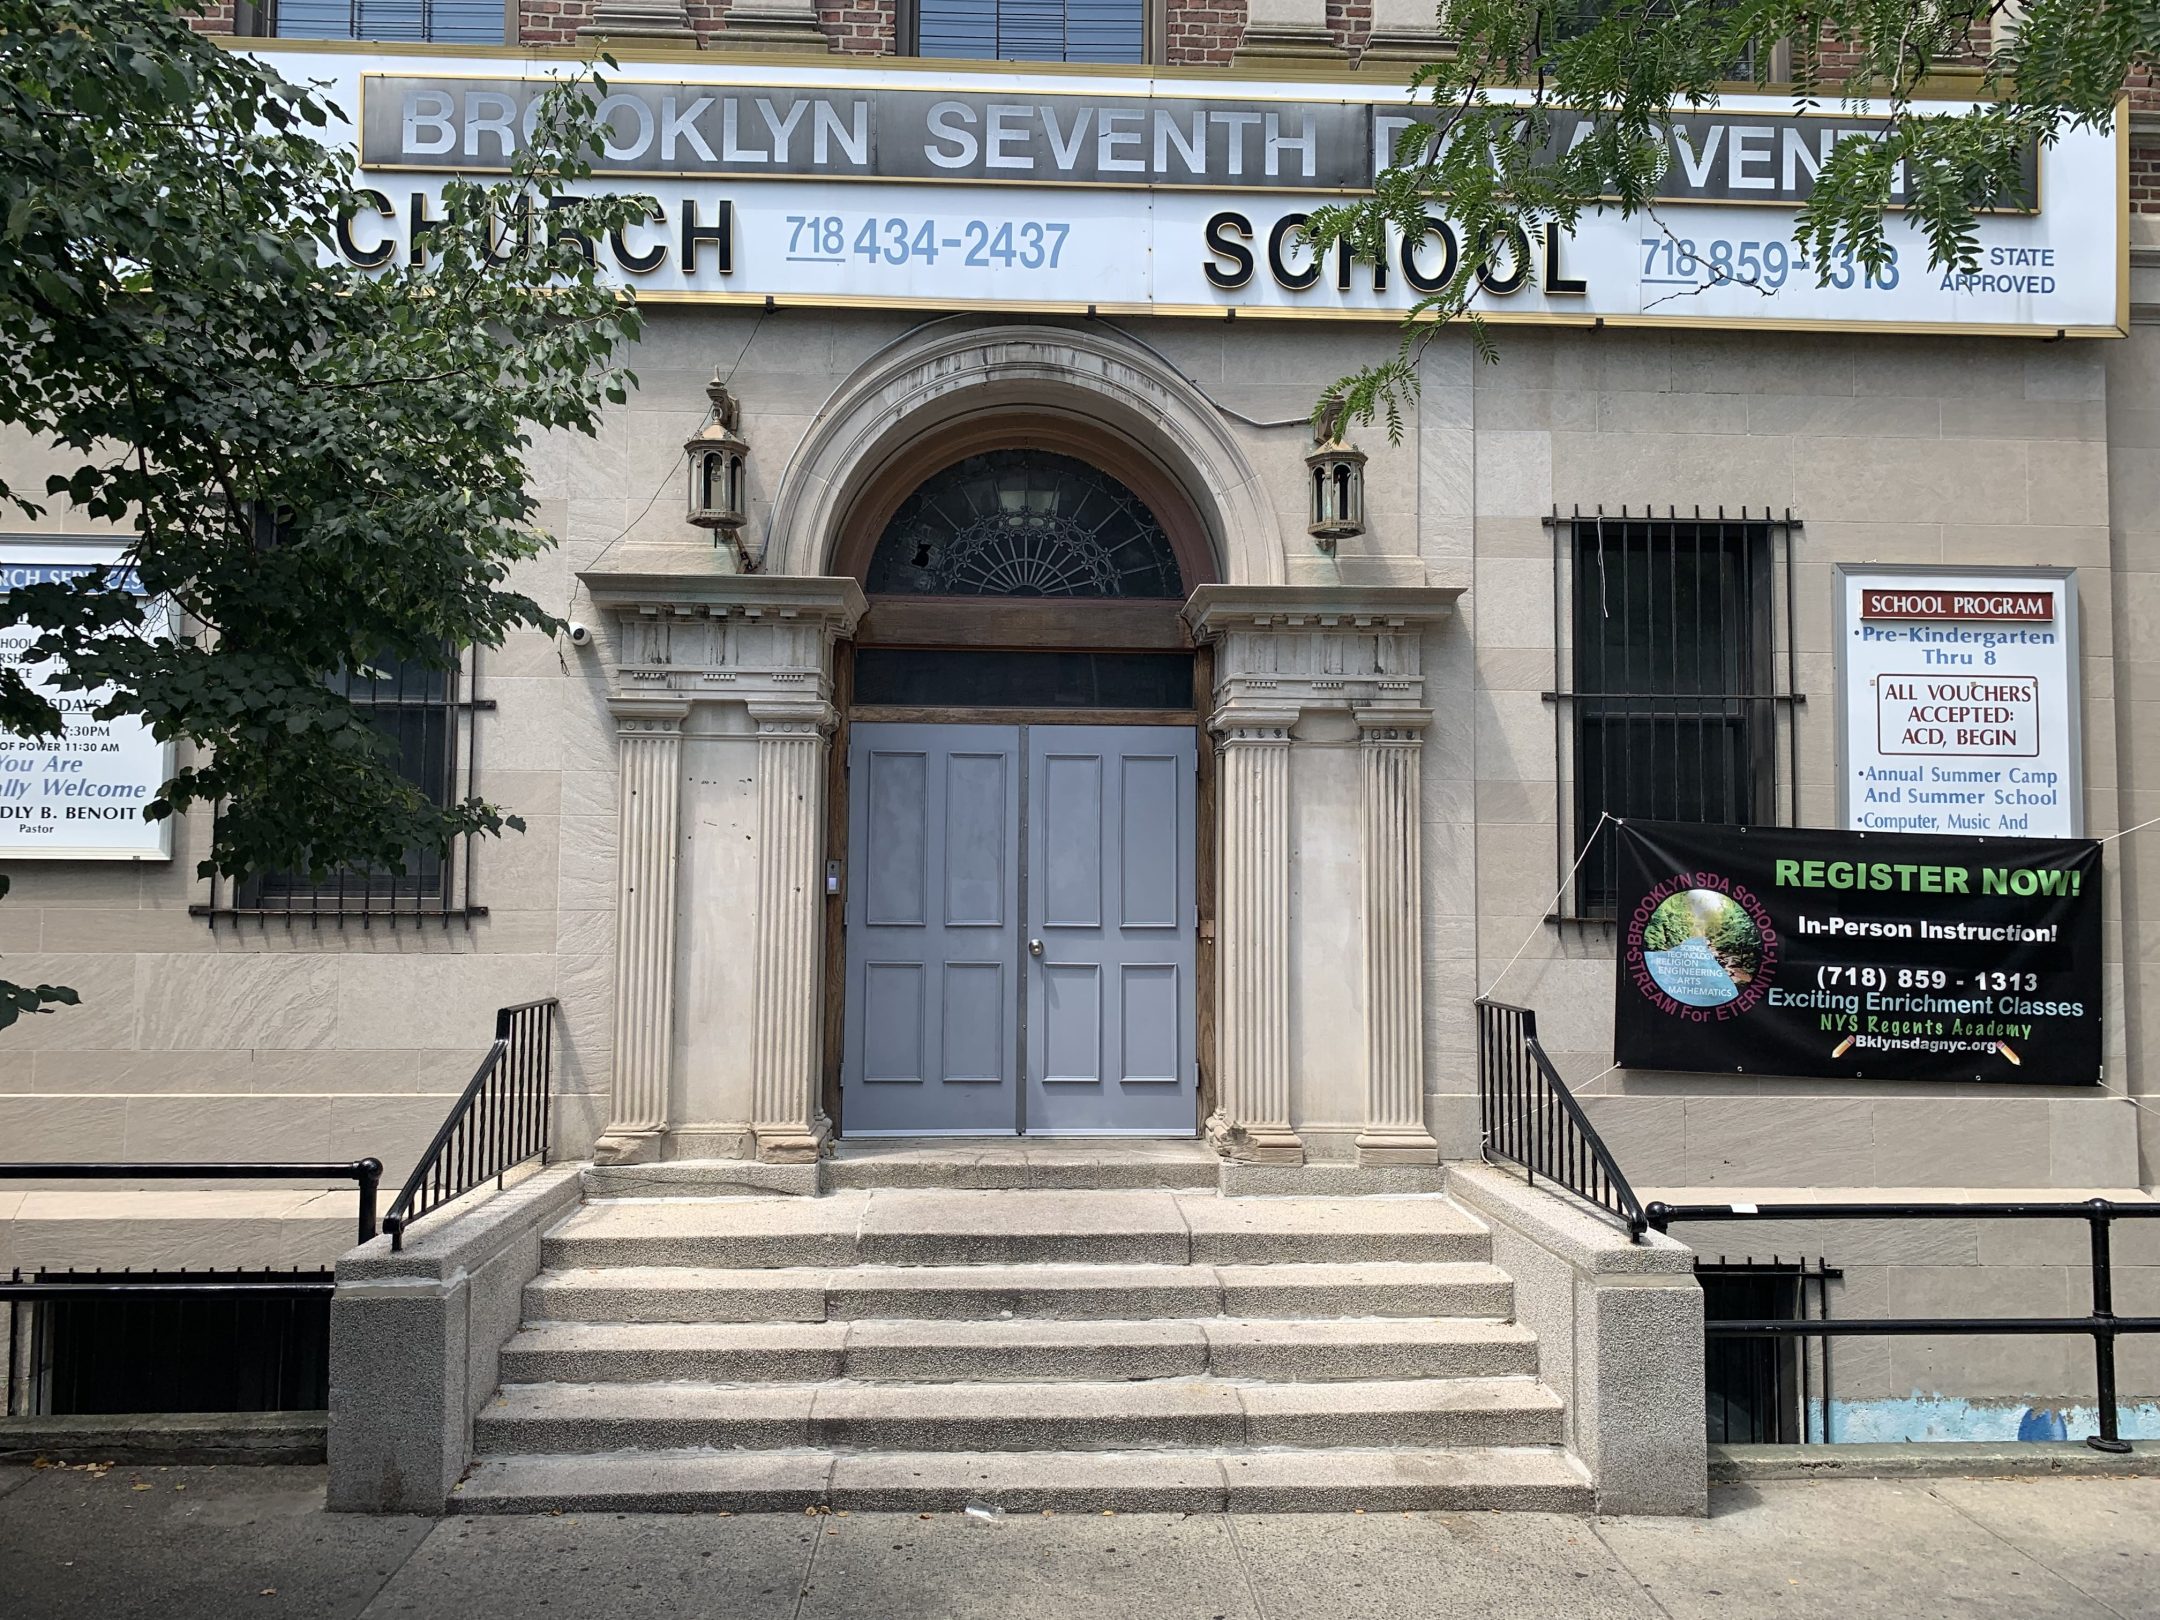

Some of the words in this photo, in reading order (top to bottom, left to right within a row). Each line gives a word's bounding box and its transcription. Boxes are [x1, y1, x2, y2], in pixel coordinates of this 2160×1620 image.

[924, 101, 1317, 177] SEVENTH
[786, 215, 845, 255] 718
[854, 217, 1071, 269] 434-2437
[1641, 238, 1698, 277] 718
[1990, 247, 2056, 267] STATE
[1940, 274, 2056, 294] APPROVED
[1871, 596, 1947, 615] SCHOOL
[1954, 597, 2044, 615] PROGRAM
[1862, 626, 2056, 648] Pre-Kindergarten
[1922, 648, 1973, 665] Thru
[1984, 650, 1997, 666] 8
[1885, 683, 1918, 701] ALL
[1927, 684, 2032, 703] VOUCHERS
[1907, 705, 2015, 724] ACCEPTED:
[19, 742, 61, 751] POWER
[65, 743, 98, 752] 11:30
[100, 743, 120, 752] AM
[1901, 728, 1948, 748] ACD,
[1957, 728, 2017, 746] BEGIN
[42, 755, 83, 773] Are
[1866, 766, 1924, 783] Annual
[1931, 766, 2001, 784] Summer
[2009, 767, 2058, 788] Camp
[43, 778, 147, 798] Welcome
[1864, 787, 1901, 804] And
[1908, 787, 1986, 805] Summer
[1994, 788, 2058, 806] School
[41, 806, 57, 819] B.
[65, 806, 137, 820] BENOIT
[1864, 812, 1940, 832] Computer,
[1947, 813, 1991, 830] Music
[1998, 813, 2029, 830] And
[19, 823, 55, 834] Pastor
[1775, 858, 1970, 894] REGISTER
[1981, 867, 2081, 897] NOW!
[1627, 872, 1693, 946] BROOKLYN
[1695, 871, 1730, 894] SDA
[1732, 885, 1778, 952] SCHOOL
[1798, 915, 1913, 938] In-Person
[1920, 920, 2058, 943] Instruction!
[1656, 957, 1699, 967] RELIGION
[1667, 951, 1716, 961] TECHNOLOGY
[1658, 966, 1724, 978] ENGINEERING
[1676, 976, 1702, 986] ARTS
[1816, 965, 1887, 992] (718)
[1897, 969, 1947, 990] 859
[1974, 971, 2038, 992] 1313
[1626, 951, 1679, 1016] STREAM
[1680, 1005, 1711, 1023] For
[1715, 955, 1778, 1021] ETERNITY
[1668, 985, 1732, 998] MATHEMATICS
[1768, 987, 1859, 1014] Exciting
[1866, 991, 1994, 1013] Enrichment
[1998, 995, 2084, 1017] Classes
[1820, 1013, 1859, 1033] NYS
[1867, 1015, 1944, 1037] Regents
[1952, 1018, 2033, 1041] Academy
[1855, 1034, 1998, 1055] Bklynsdagnyc.org
